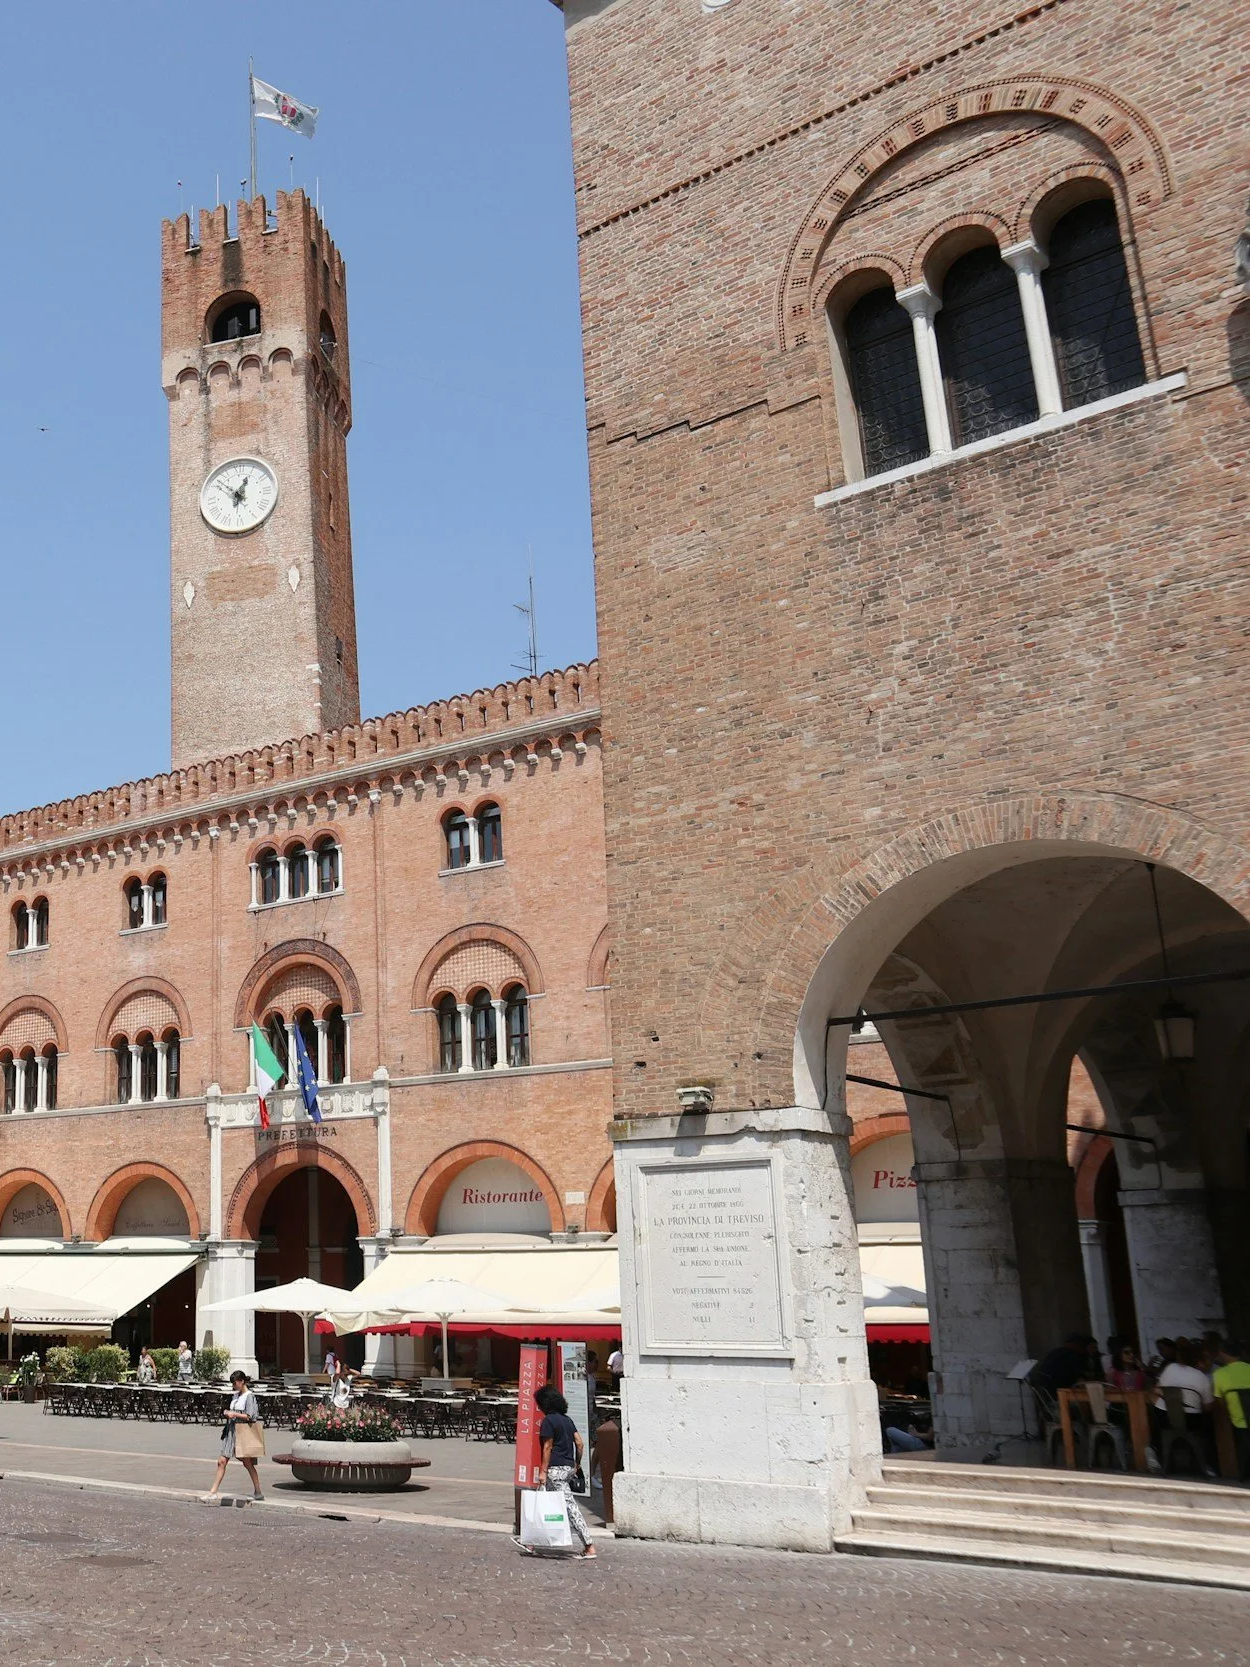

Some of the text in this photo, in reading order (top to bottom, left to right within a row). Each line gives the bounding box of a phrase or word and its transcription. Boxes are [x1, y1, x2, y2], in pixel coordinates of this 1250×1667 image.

[257, 1127, 338, 1141] PREFETTURA
[462, 1188, 543, 1204] Ristorante
[654, 1214, 765, 1226] LA PROVINCIA DI TREVISO
[701, 1245, 710, 1253] LA
[521, 1361, 532, 1434] LA PIAZZA
